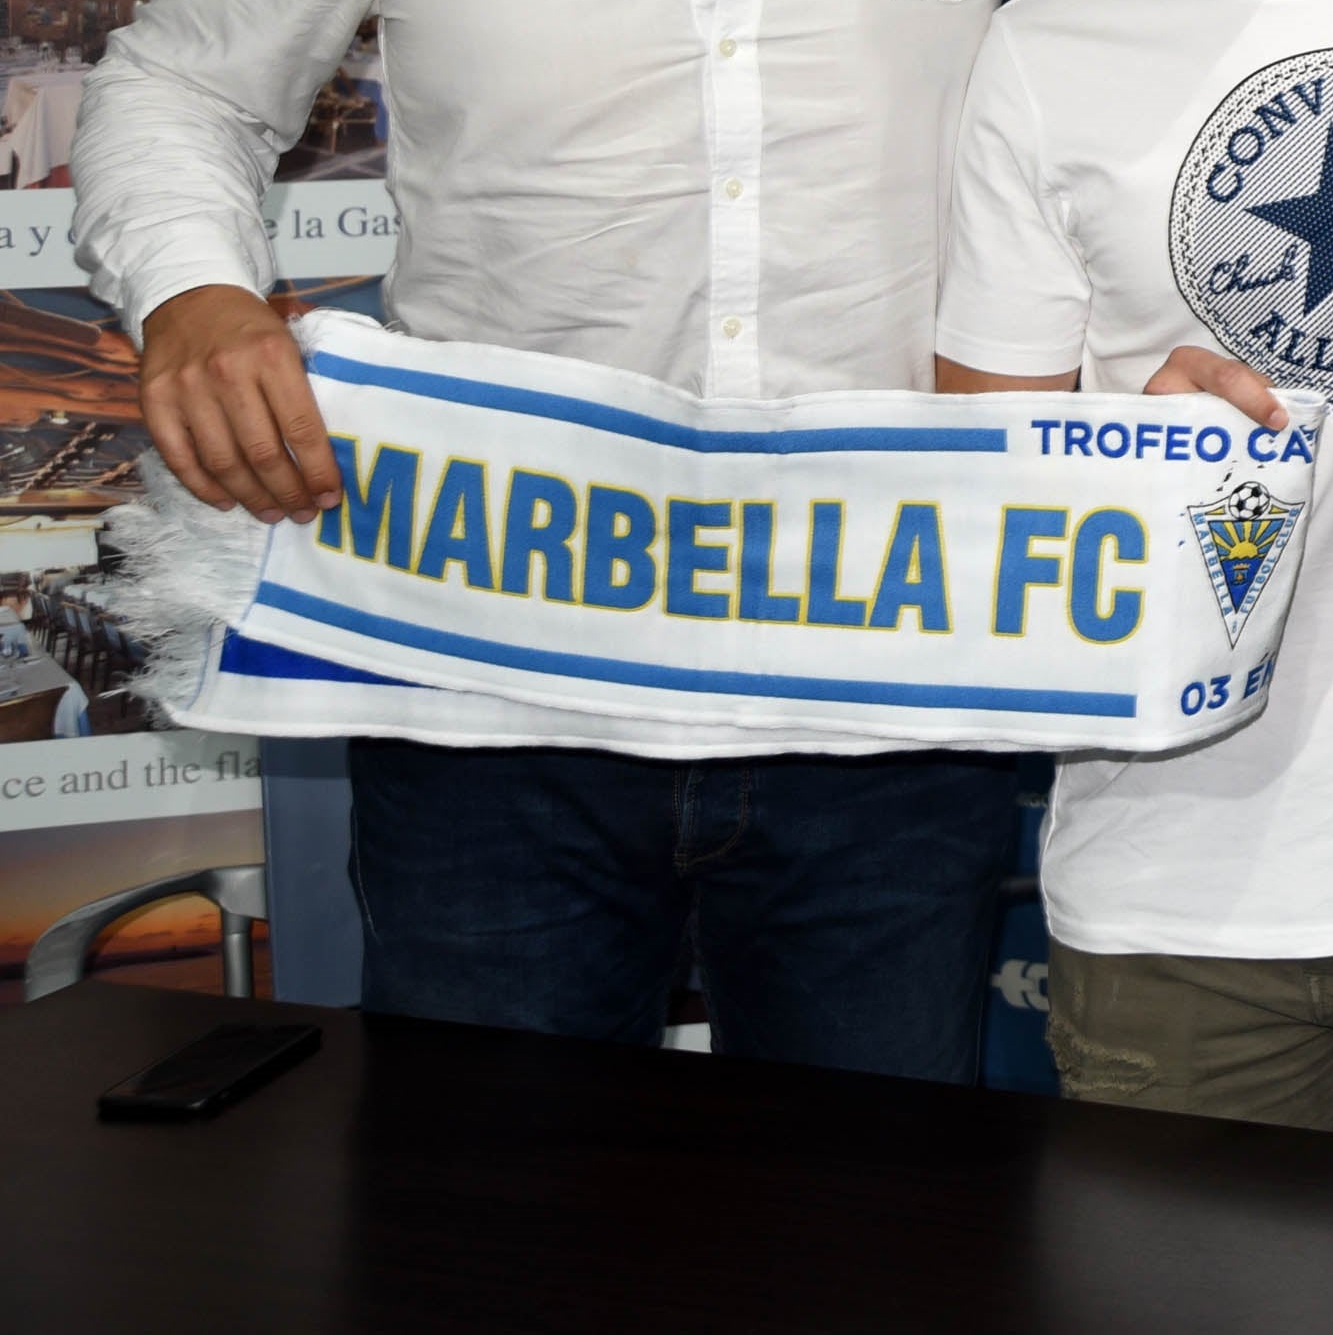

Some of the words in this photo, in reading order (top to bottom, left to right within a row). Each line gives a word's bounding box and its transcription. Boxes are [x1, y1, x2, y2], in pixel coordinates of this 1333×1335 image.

[27, 224, 53, 257] y
[290, 209, 325, 240] la
[1030, 419, 1232, 465] TROFEO
[316, 431, 954, 634] MARBELLA
[991, 503, 1150, 645] FC
[1193, 511, 1234, 616] MARBELLA
[1180, 673, 1232, 717] 03
[60, 759, 129, 795] and
[144, 756, 202, 788] the
